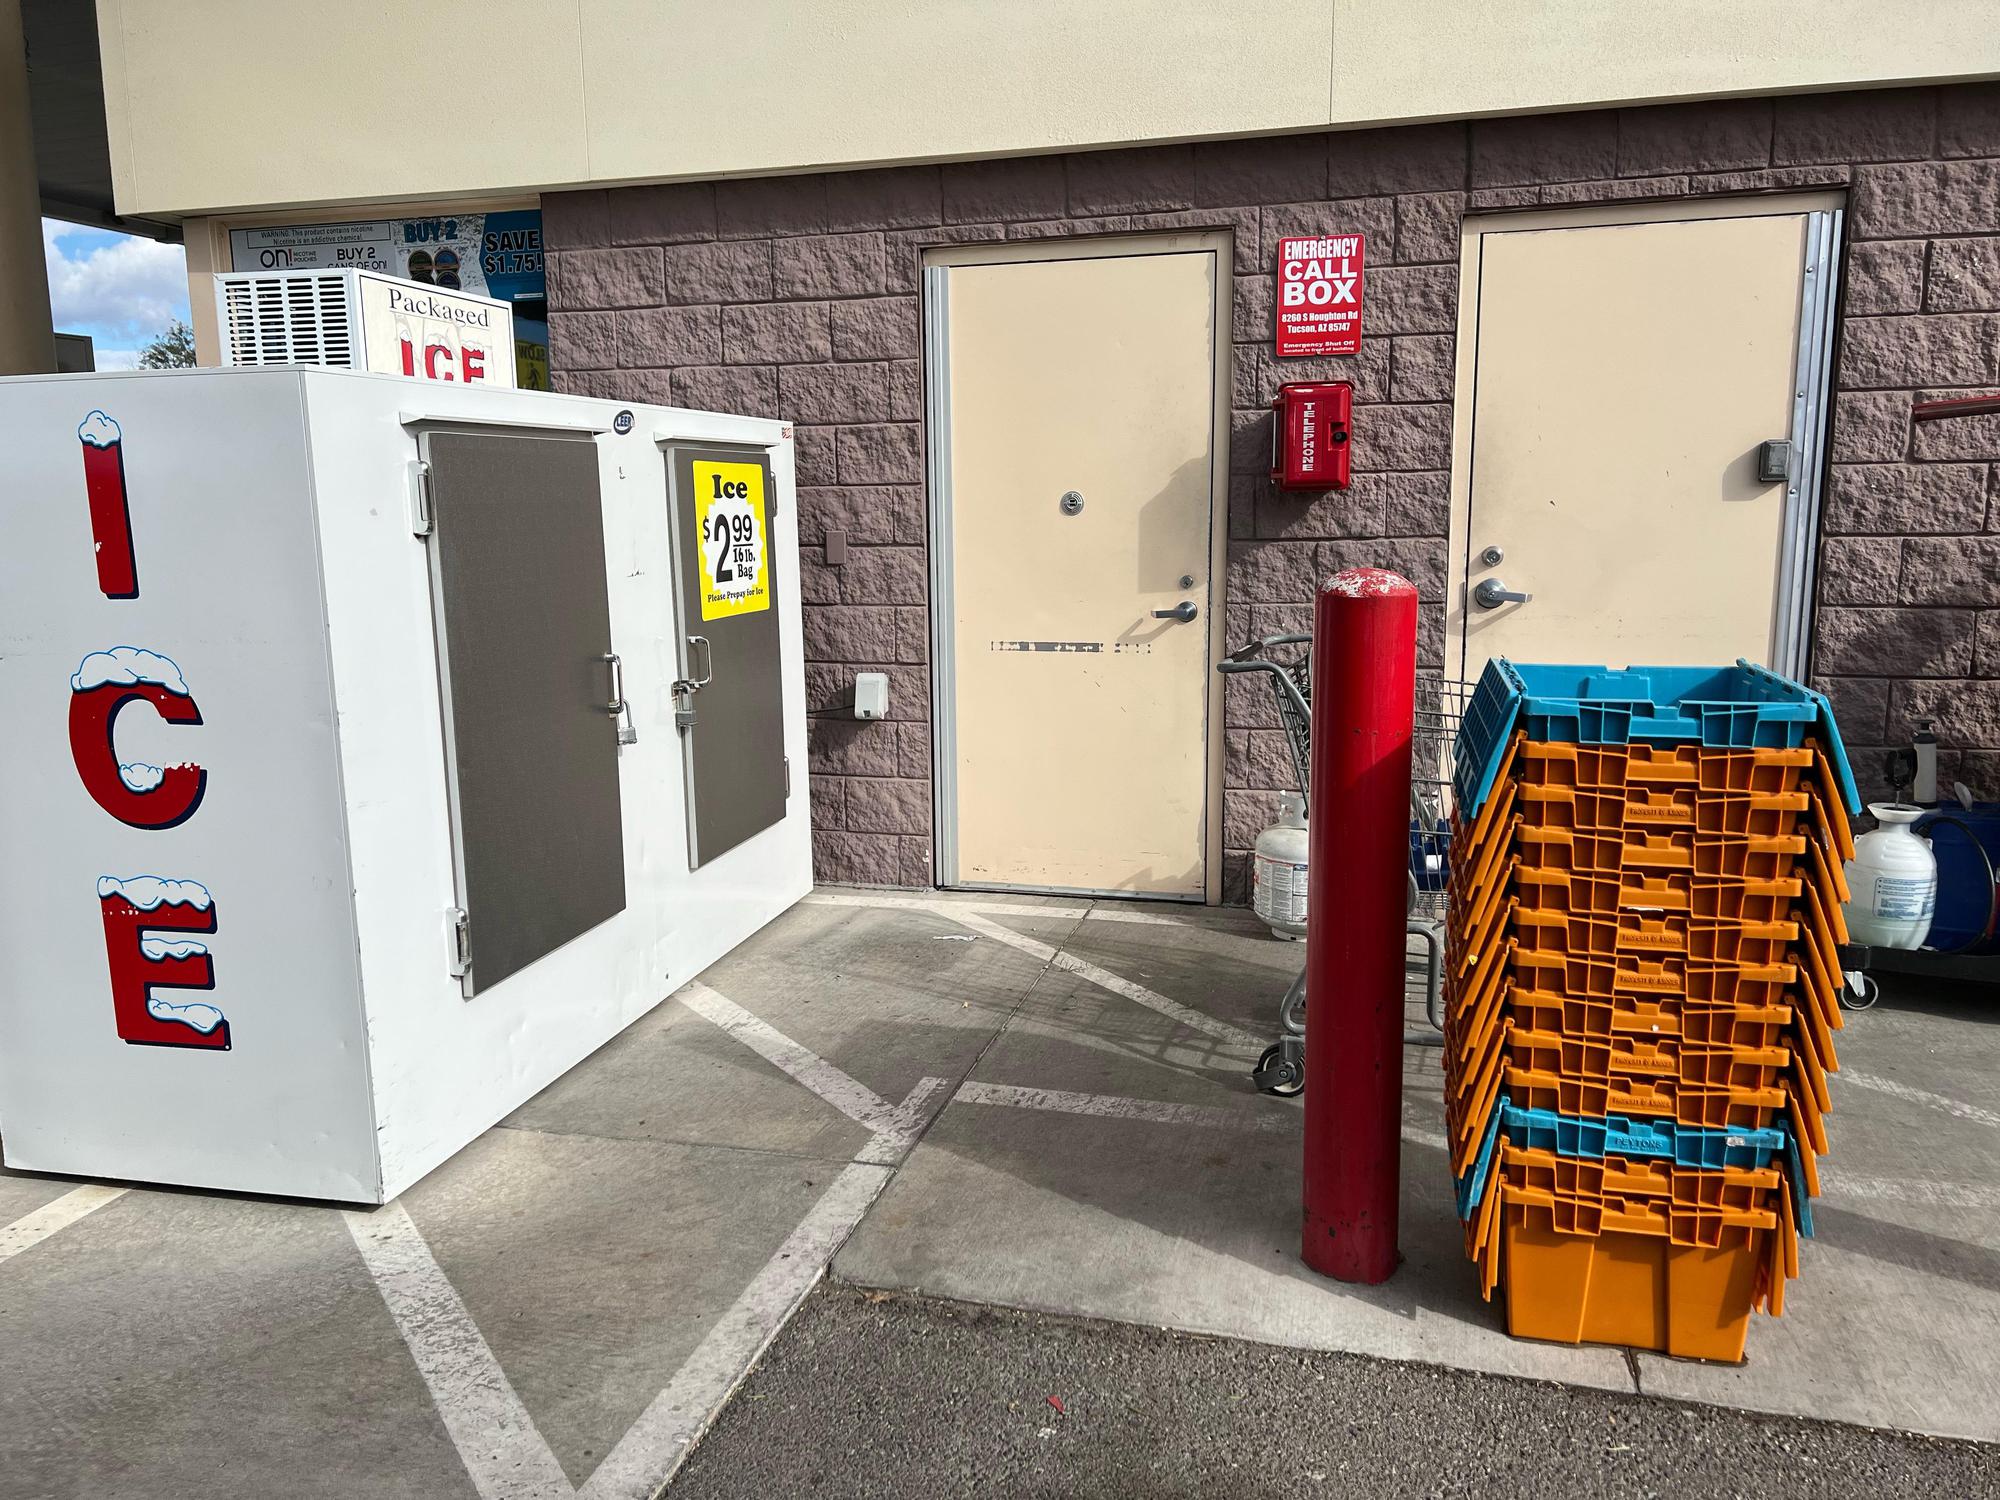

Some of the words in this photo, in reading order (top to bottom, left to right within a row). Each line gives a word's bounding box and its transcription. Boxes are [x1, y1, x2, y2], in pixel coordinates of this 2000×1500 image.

[292, 229, 303, 237] This
[304, 228, 326, 237] product
[327, 227, 349, 235] contains
[311, 235, 336, 243] addictive
[403, 221, 441, 243] BUY
[446, 220, 458, 240] 2
[484, 229, 540, 253] SAVE
[337, 248, 363, 261] BUY
[367, 247, 376, 259] 2
[1284, 237, 1359, 260] EMERGENCY
[484, 252, 543, 275] $1.75!
[1284, 258, 1358, 281] CALL
[1283, 279, 1357, 306] BOX
[387, 288, 489, 327] Packaged
[1281, 313, 1301, 322] 8260
[1302, 312, 1308, 322] S
[1309, 311, 1347, 321] Houghton
[1347, 310, 1358, 320] Rd
[1287, 324, 1317, 334] Tucson,
[1317, 323, 1327, 333] AZ
[1328, 322, 1351, 332] 85747
[1302, 402, 1316, 472] TELEPHONE
[711, 474, 748, 499] Ice
[733, 548, 744, 563] 16
[745, 548, 755, 562] lb.
[737, 564, 753, 580] Bag
[707, 592, 726, 603] Please
[727, 589, 746, 600] Prepay
[746, 588, 755, 596] for
[756, 587, 764, 595] Ice
[69, 411, 232, 1051] ICE
[1615, 1137, 1664, 1149] PEYTONS
